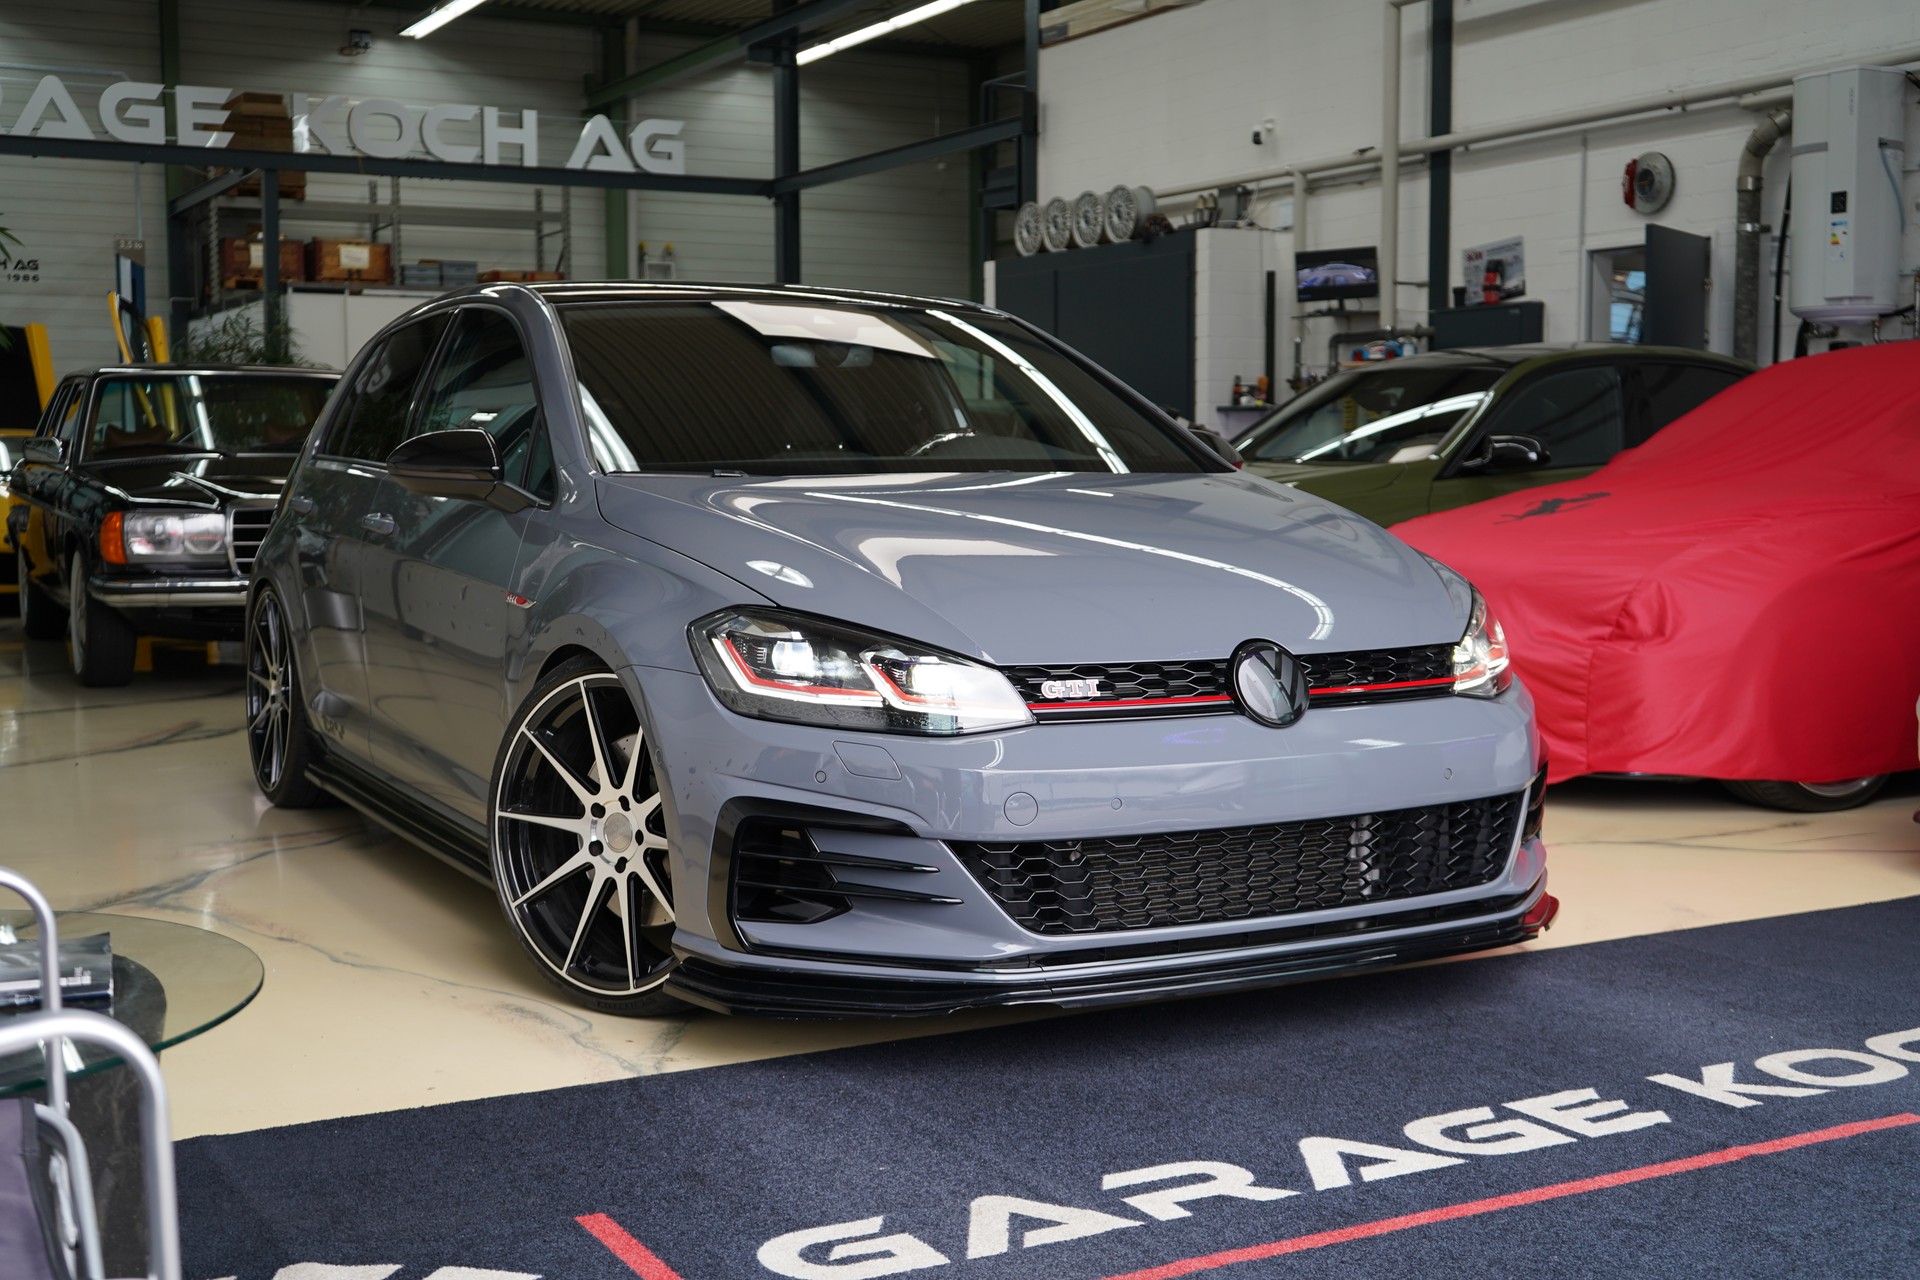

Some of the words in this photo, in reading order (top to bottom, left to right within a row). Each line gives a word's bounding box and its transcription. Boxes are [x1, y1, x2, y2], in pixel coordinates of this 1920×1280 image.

[0, 75, 235, 148] AGE
[292, 92, 538, 168] KOCH
[565, 113, 686, 174] AG
[13, 259, 40, 270] AG
[7, 273, 40, 281] 1986
[1041, 679, 1101, 699] GTI
[757, 1088, 1672, 1280] GARAGE
